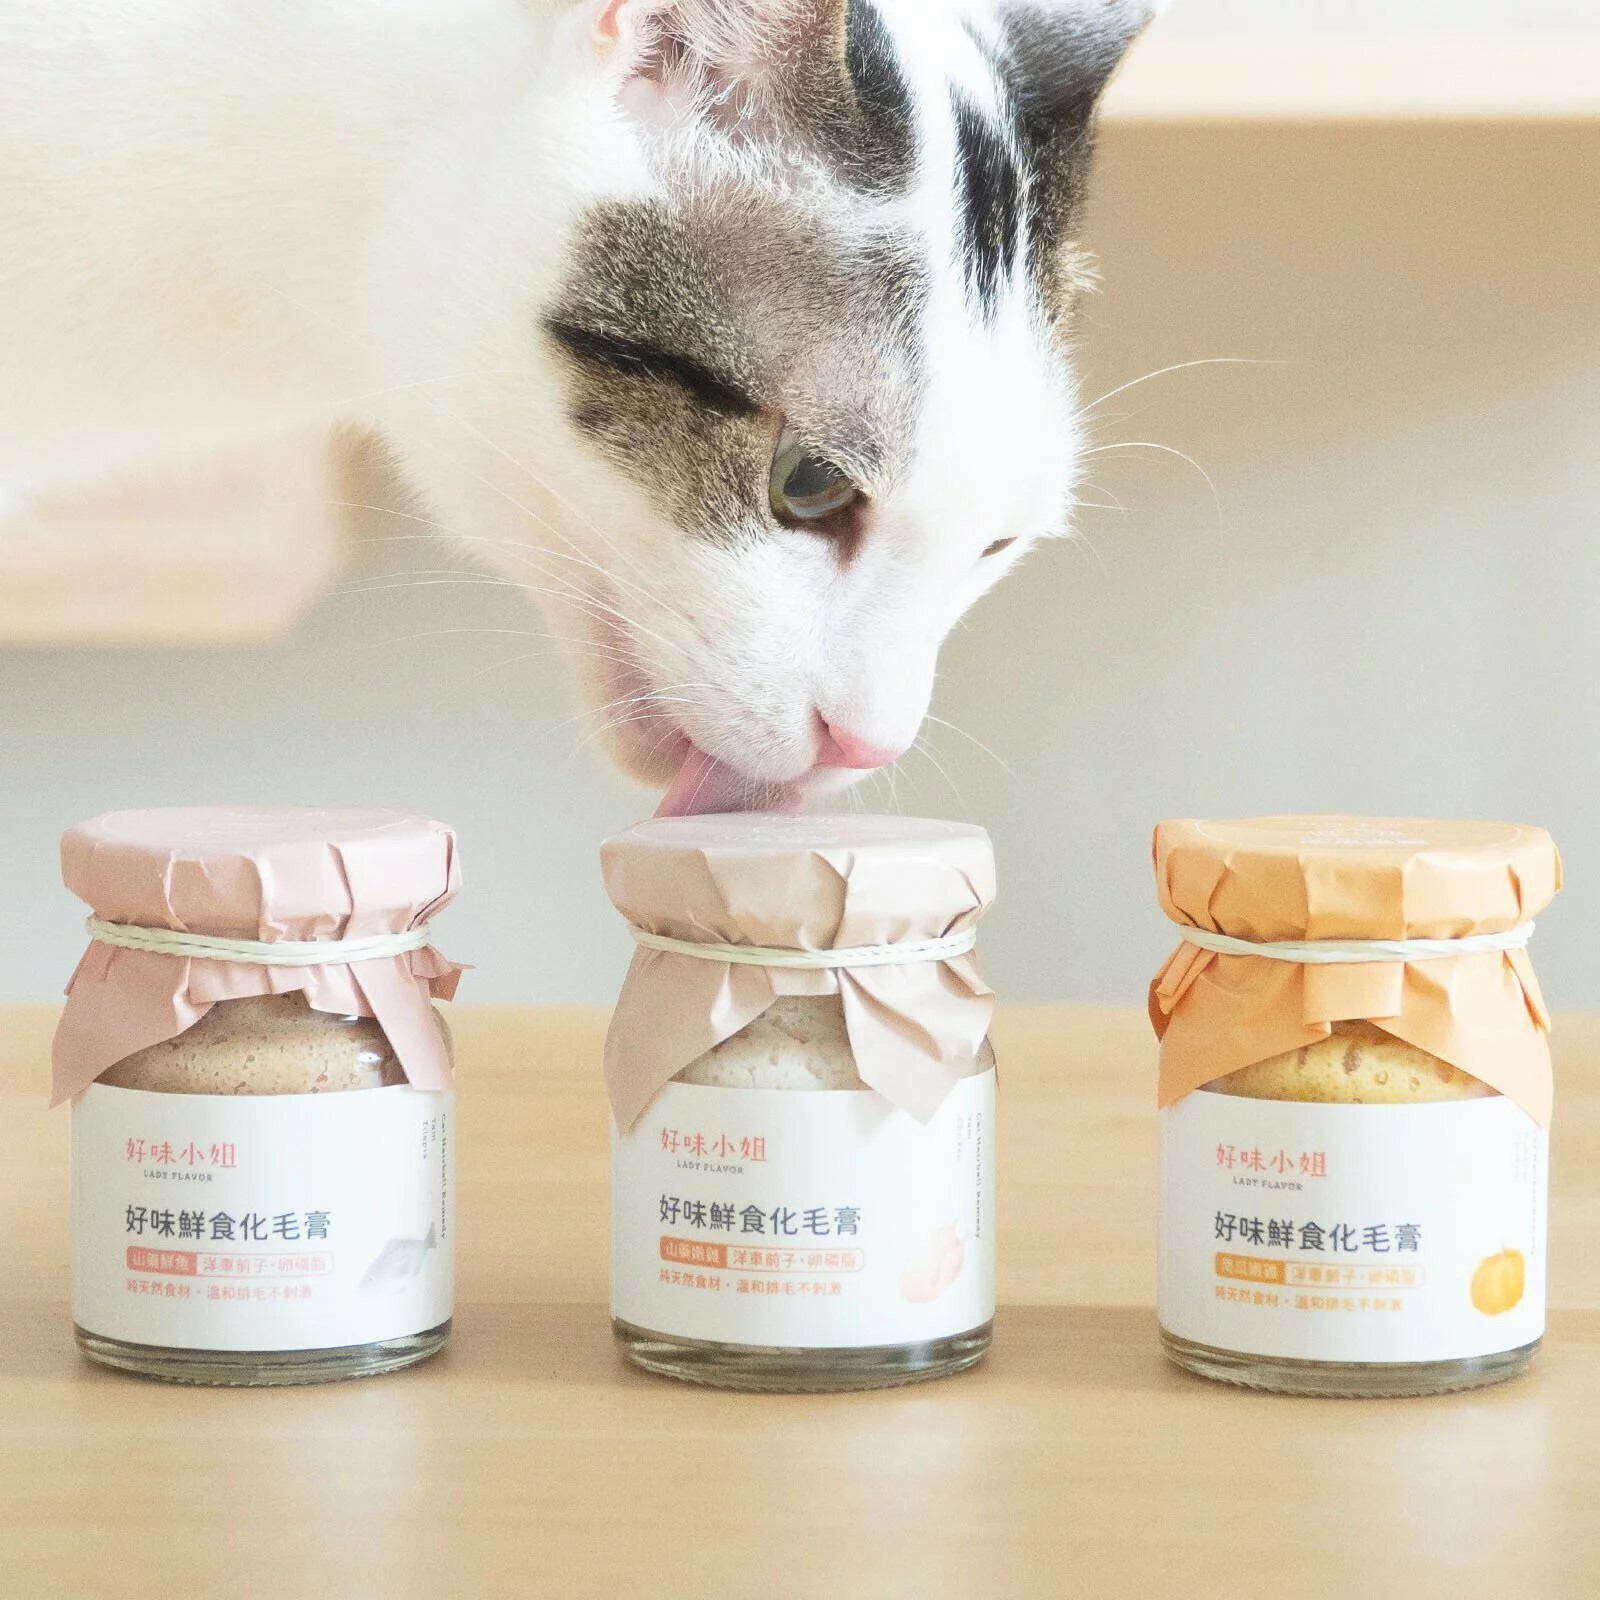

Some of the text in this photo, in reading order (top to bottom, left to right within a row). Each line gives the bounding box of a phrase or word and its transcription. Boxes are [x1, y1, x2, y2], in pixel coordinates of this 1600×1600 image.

[125, 1137, 237, 1168] 好味小姐
[660, 1127, 768, 1162] 好味小姐
[1215, 1143, 1328, 1177] 好味小姐
[143, 1169, 213, 1182] LADY FLAVOR
[676, 1159, 744, 1175] LADY FLAVOR
[1232, 1176, 1304, 1192] LADY FLAVOR
[125, 1204, 331, 1241] 好味鮮食化毛膏
[659, 1194, 861, 1236] 好味鮮食化毛膏
[1214, 1211, 1422, 1252] 好味鮮食化毛膏
